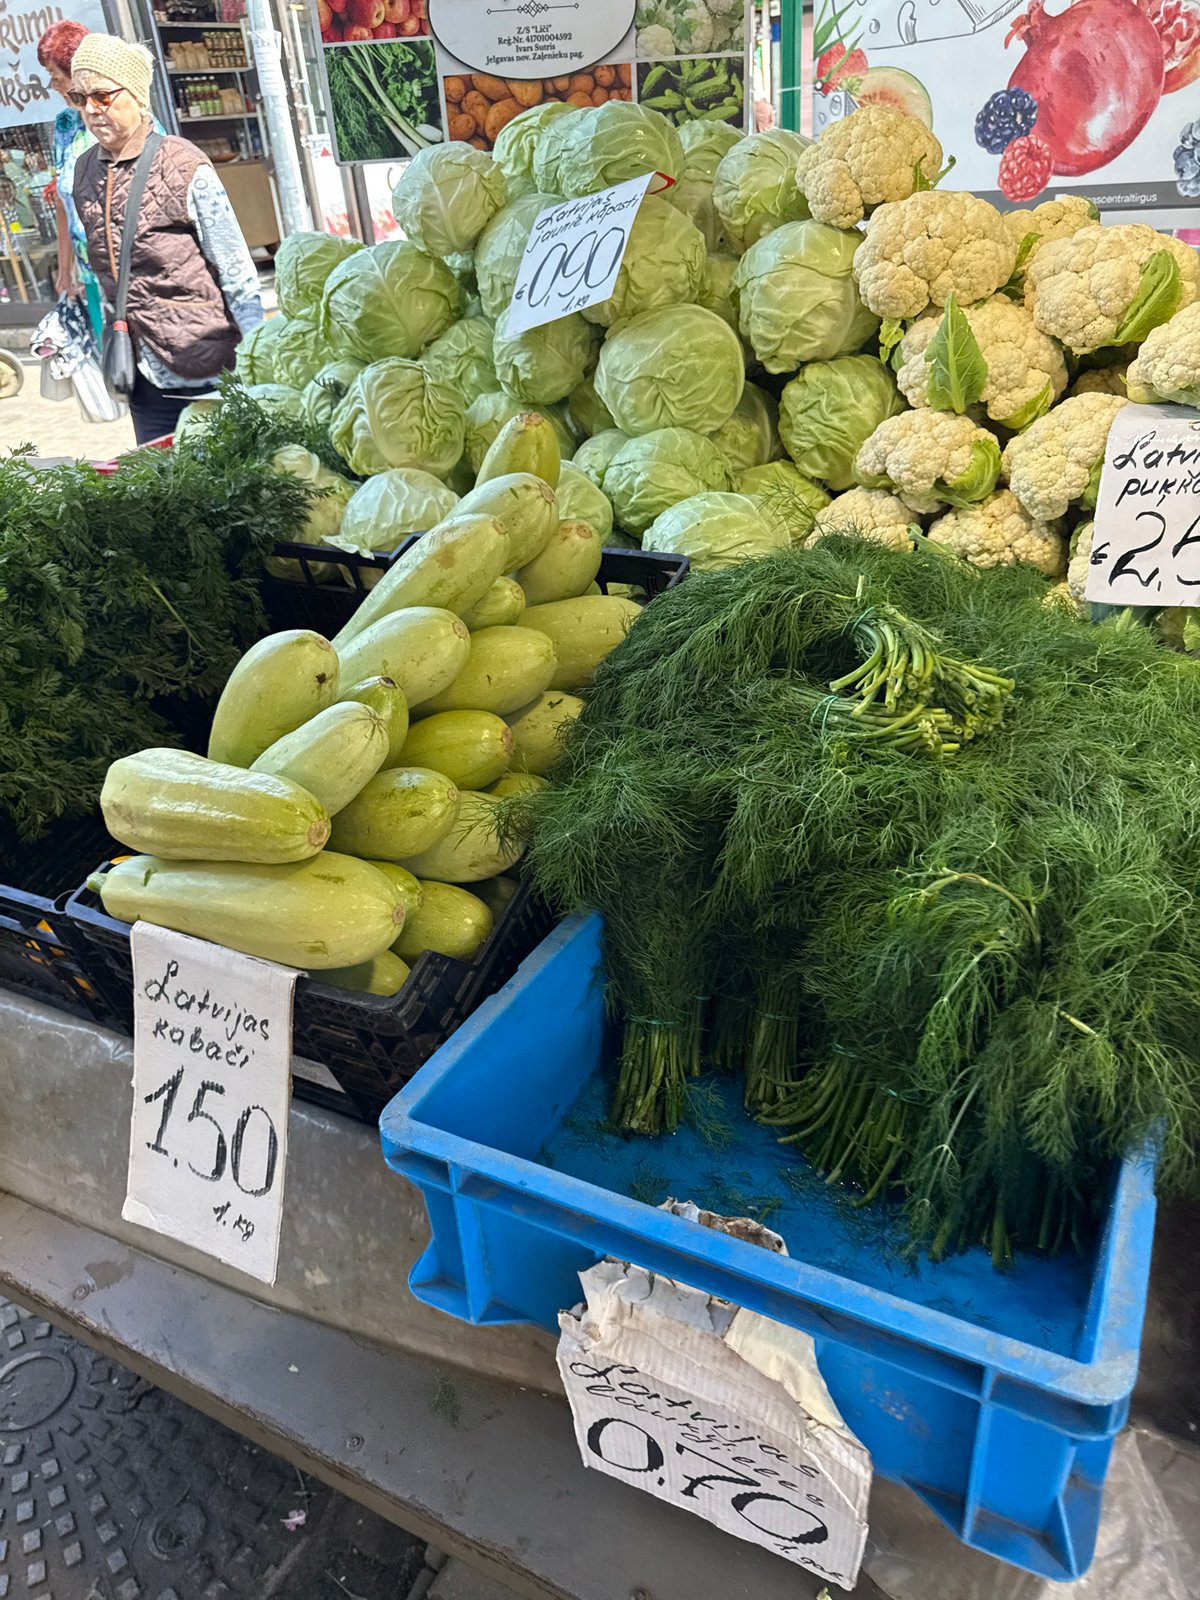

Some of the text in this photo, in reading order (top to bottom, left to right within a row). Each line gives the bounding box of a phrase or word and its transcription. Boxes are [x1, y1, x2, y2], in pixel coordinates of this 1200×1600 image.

[525, 32, 572, 43] 41701004592
[515, 44, 533, 53] Ivars
[485, 55, 515, 66] Jelgavas
[532, 52, 568, 62] Zaļenieku
[569, 51, 584, 60] pag.
[1088, 193, 1158, 205] ascentraltirgus
[144, 959, 270, 1041] Latvijas
